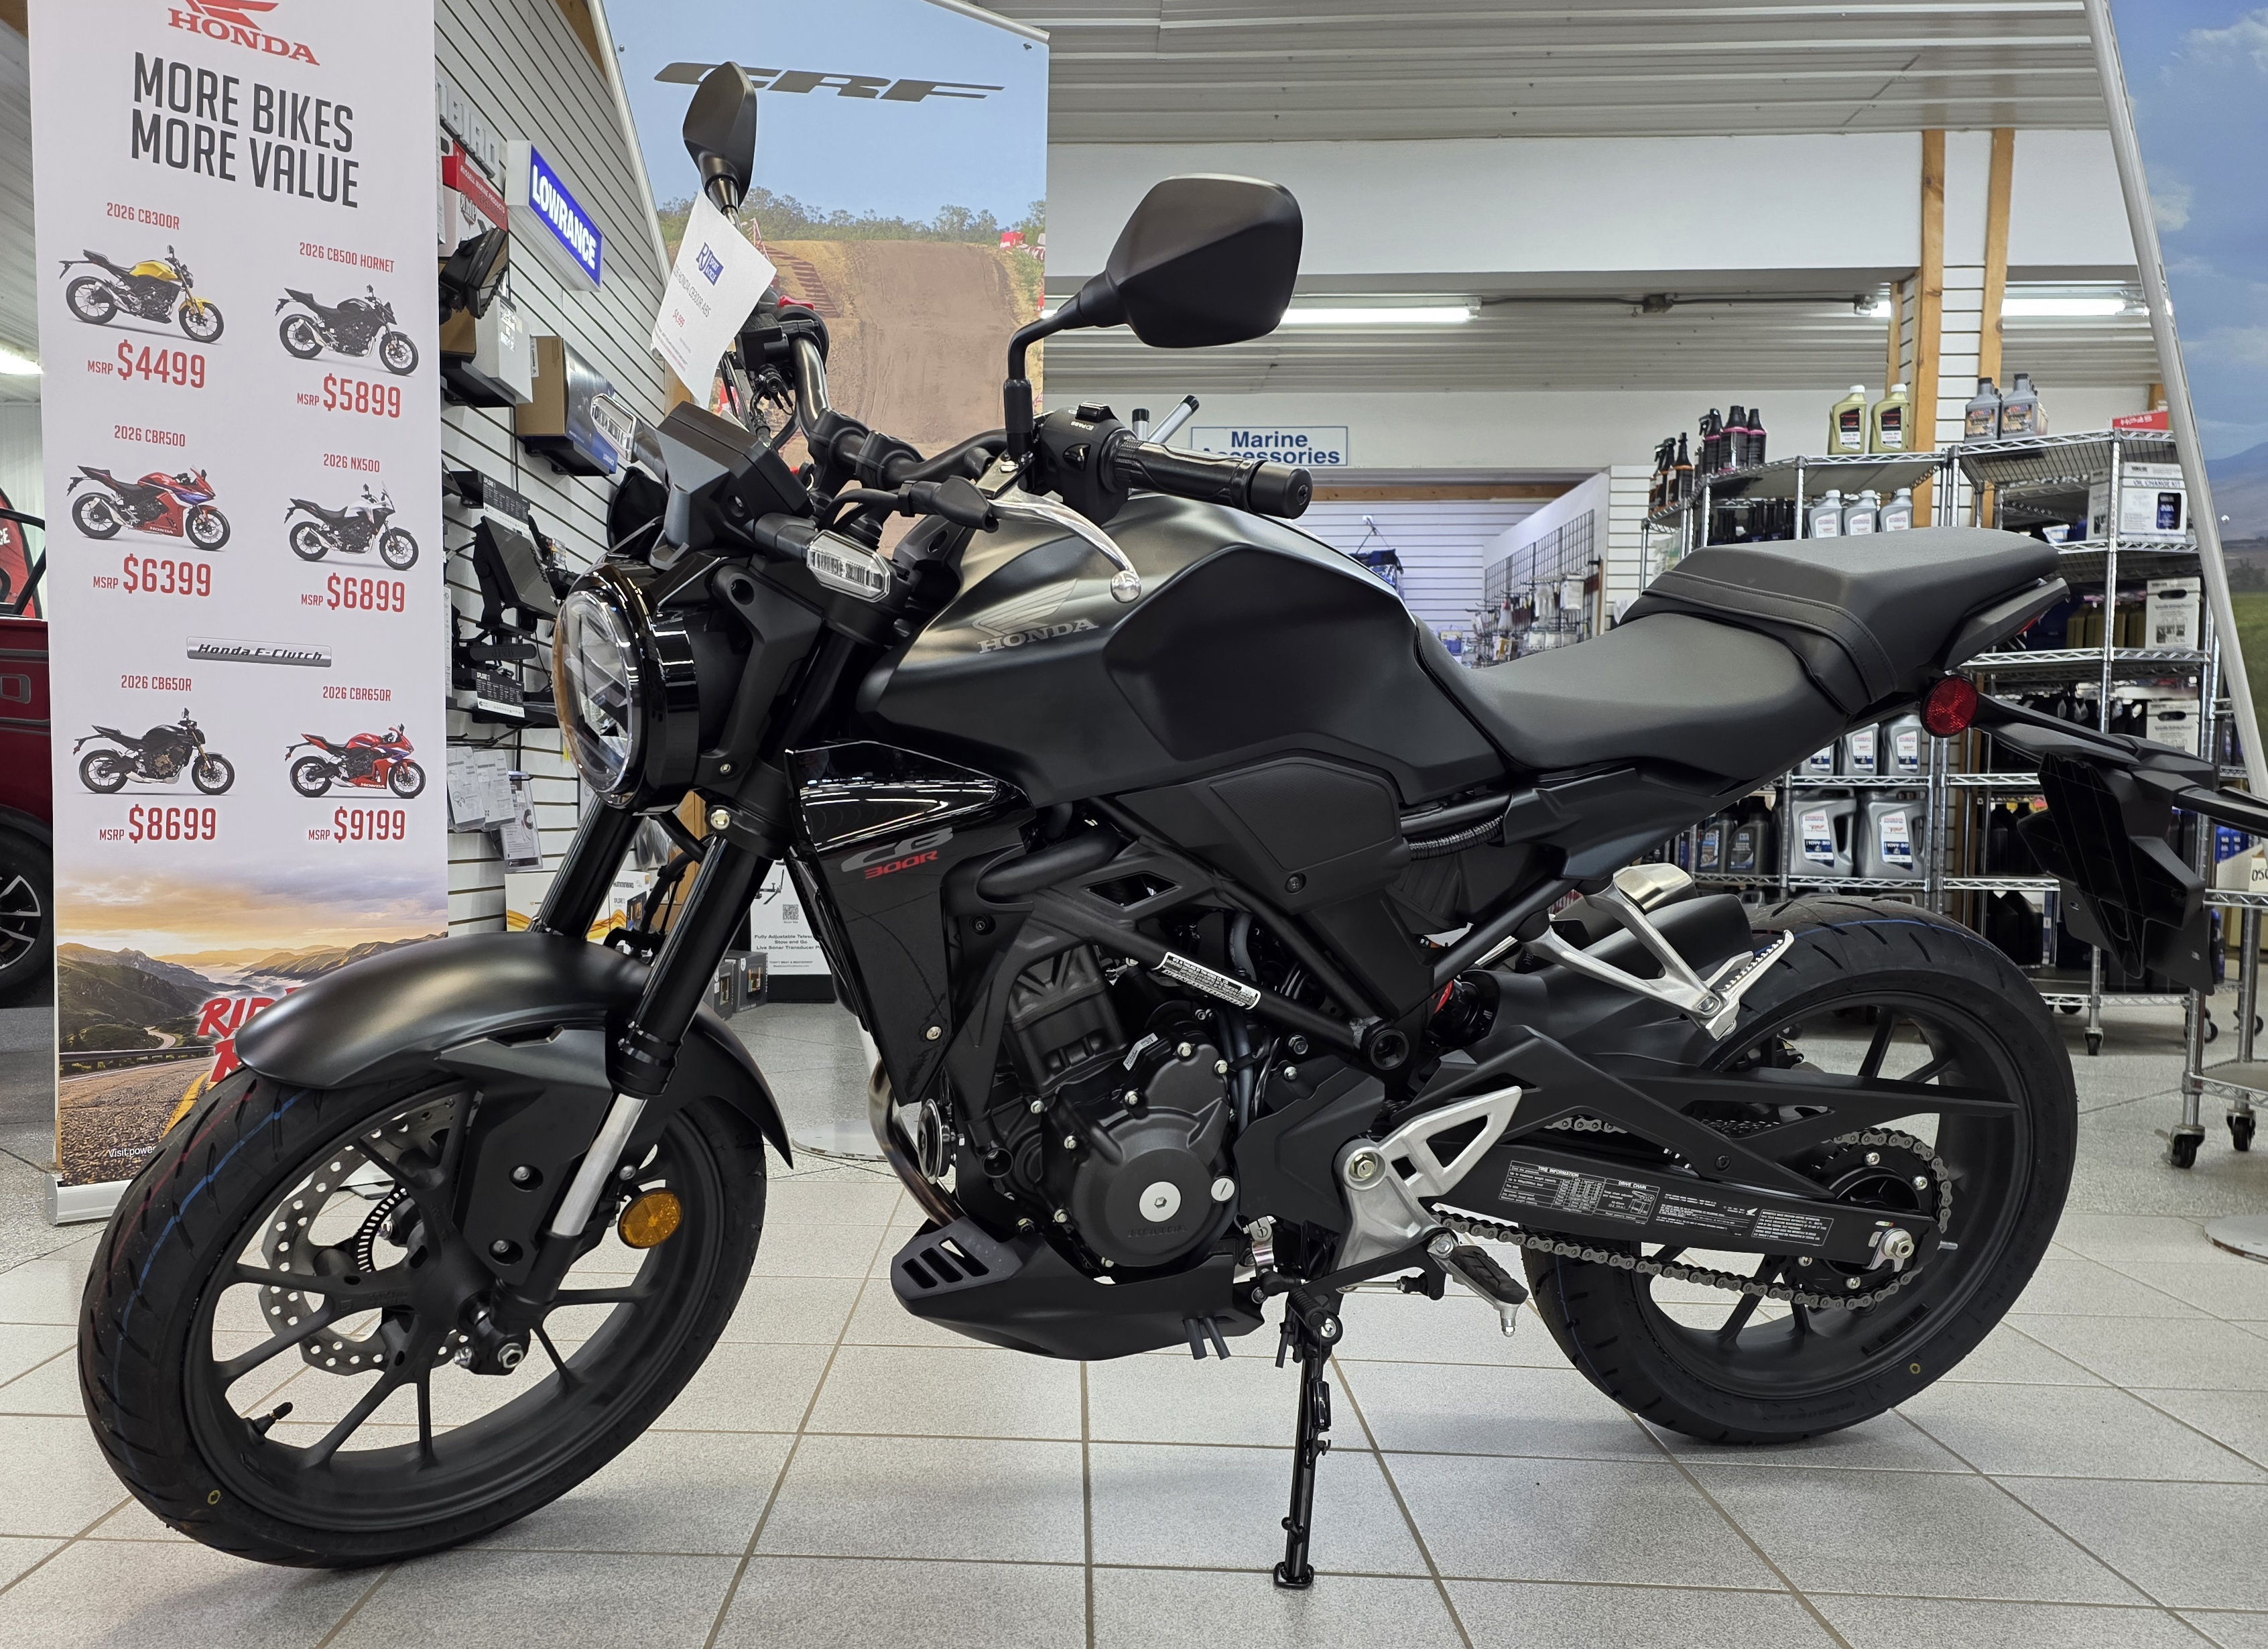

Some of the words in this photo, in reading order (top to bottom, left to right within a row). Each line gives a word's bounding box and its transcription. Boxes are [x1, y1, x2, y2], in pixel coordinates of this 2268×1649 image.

[168, 8, 320, 66] HONDA
[134, 52, 239, 127] MORE
[253, 83, 353, 153] BIKES
[131, 108, 237, 182] MORE
[249, 137, 359, 208] VALUE
[107, 202, 135, 221] 2026
[137, 208, 180, 230] CB300R
[533, 165, 596, 269] LOWRANCE
[299, 242, 324, 259] 2026
[326, 247, 357, 265] CB500
[360, 254, 395, 273] HORNET
[87, 360, 113, 375] MSRP
[117, 339, 206, 388] $4499
[297, 393, 320, 407] MSRP
[323, 373, 401, 418] $5899
[114, 425, 142, 442] 2026
[145, 429, 186, 447] CBR500
[1231, 430, 1308, 448] Marine
[323, 454, 347, 469] 2026
[351, 456, 380, 473] NX500
[93, 576, 119, 589] MSRP
[123, 554, 211, 597] $6399
[301, 594, 323, 606] MSRP
[326, 572, 405, 612] $6899
[198, 644, 251, 658] Honda
[254, 647, 322, 662] E-Clutch
[976, 618, 1099, 654] HONDA
[121, 675, 149, 690] 2026
[151, 677, 192, 692] CB650R
[322, 686, 346, 700] 2026
[350, 688, 391, 702] CBR650R
[99, 829, 125, 841] MSRP
[128, 804, 216, 843] $8699
[308, 829, 330, 841] MSRP
[334, 806, 405, 843] $9199
[841, 827, 953, 872] CB
[865, 850, 938, 879] 300R
[108, 1148, 127, 1158] Visit
[1550, 1168, 1579, 1178] INFORMATION
